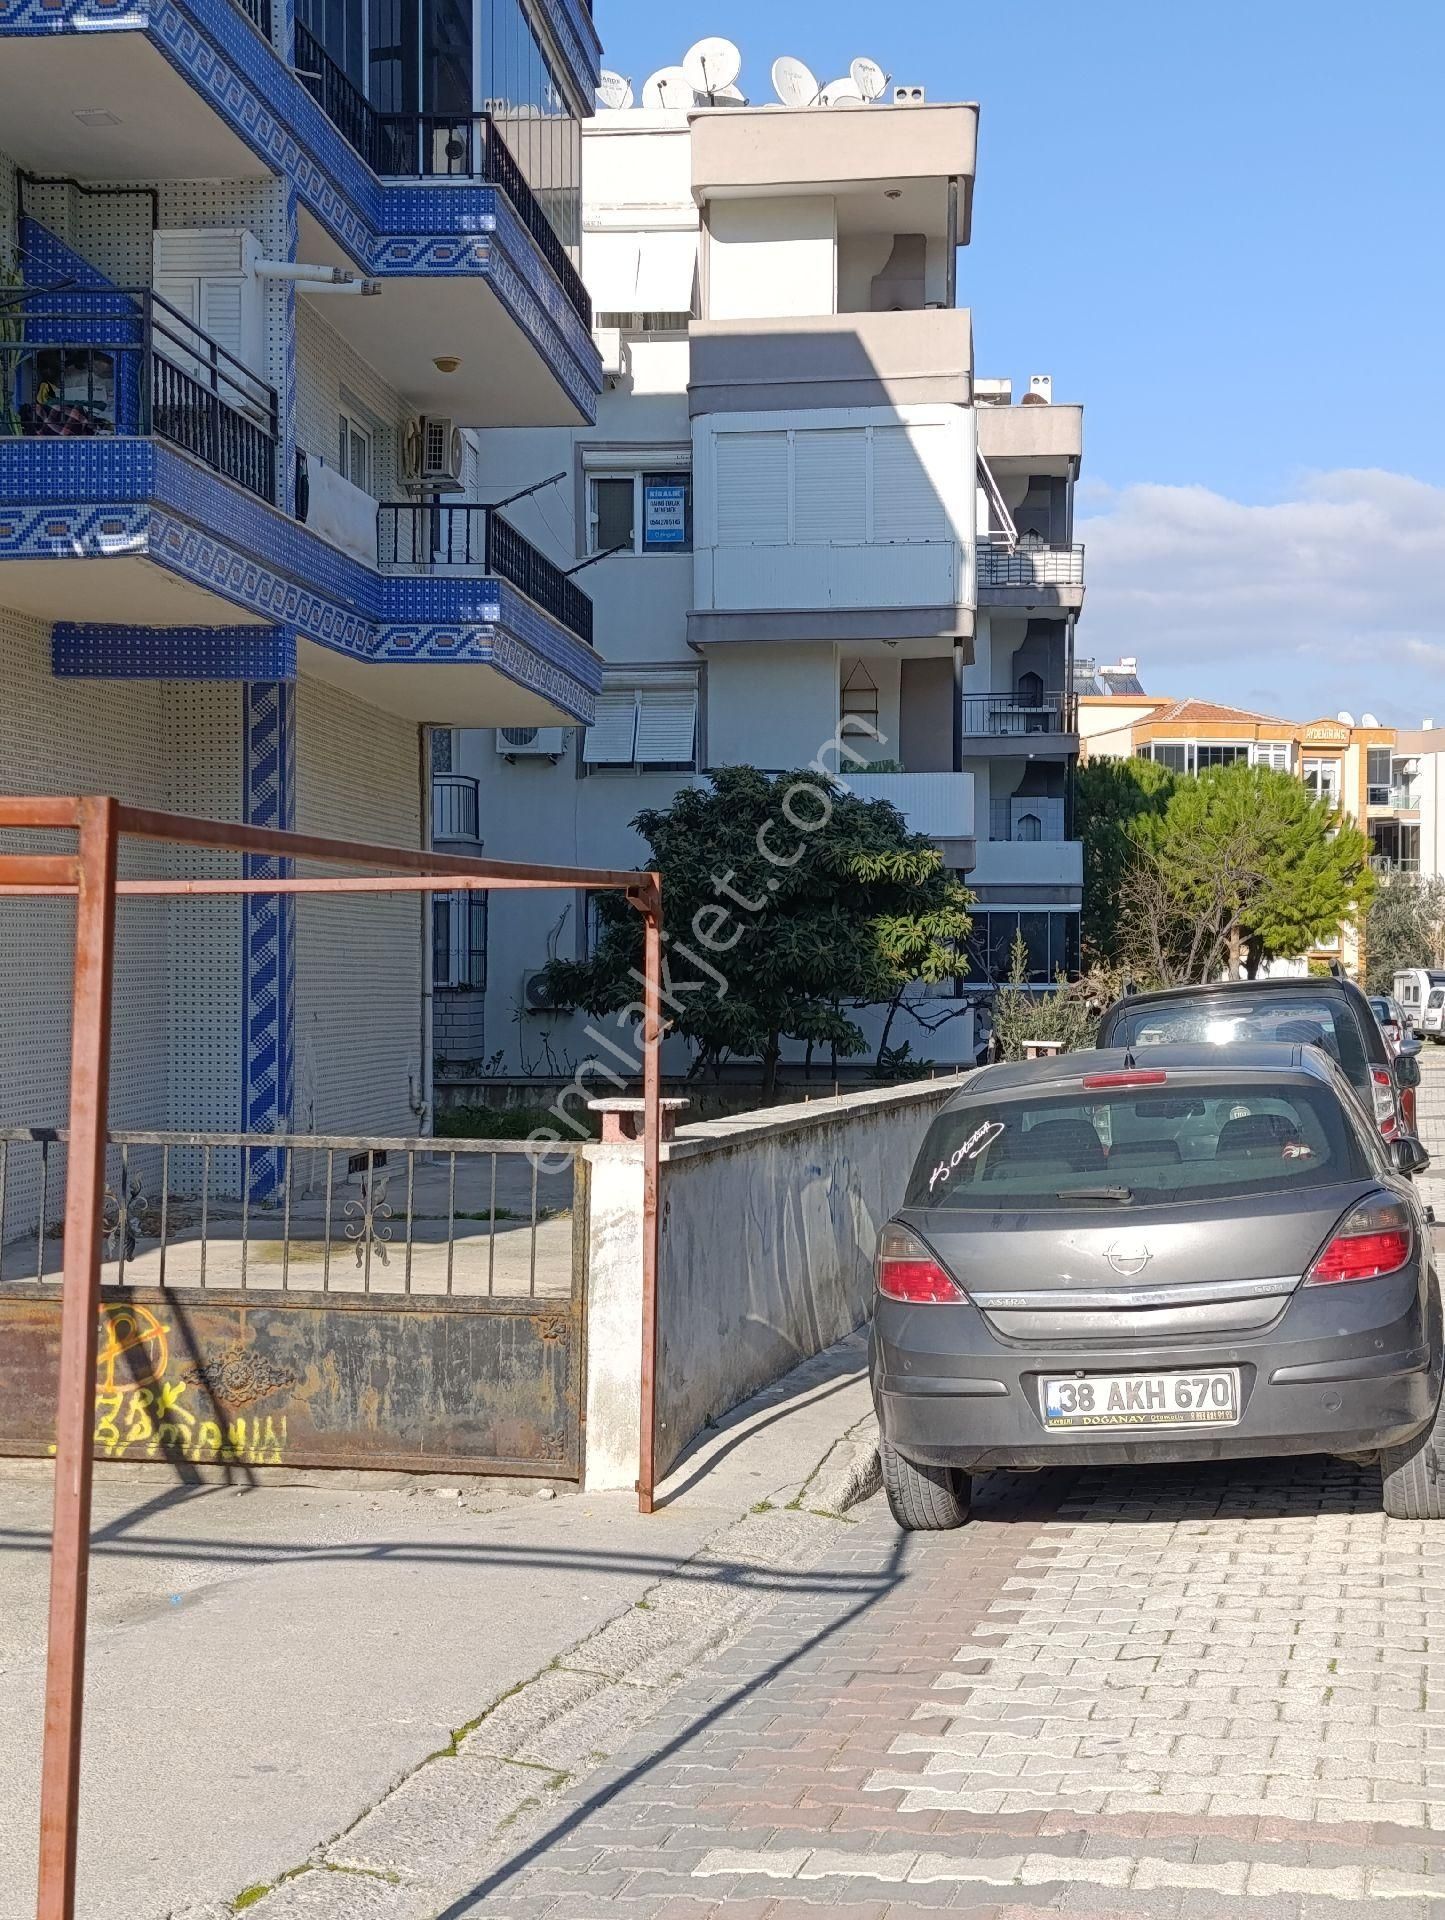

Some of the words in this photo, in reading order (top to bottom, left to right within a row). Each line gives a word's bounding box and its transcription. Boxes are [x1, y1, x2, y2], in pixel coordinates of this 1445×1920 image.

[987, 1298, 1028, 1306] ASTRA
[95, 1380, 196, 1427] ARK
[1059, 1383, 1096, 1412] 38
[1107, 1380, 1166, 1411] AKH
[1174, 1377, 1229, 1408] 670
